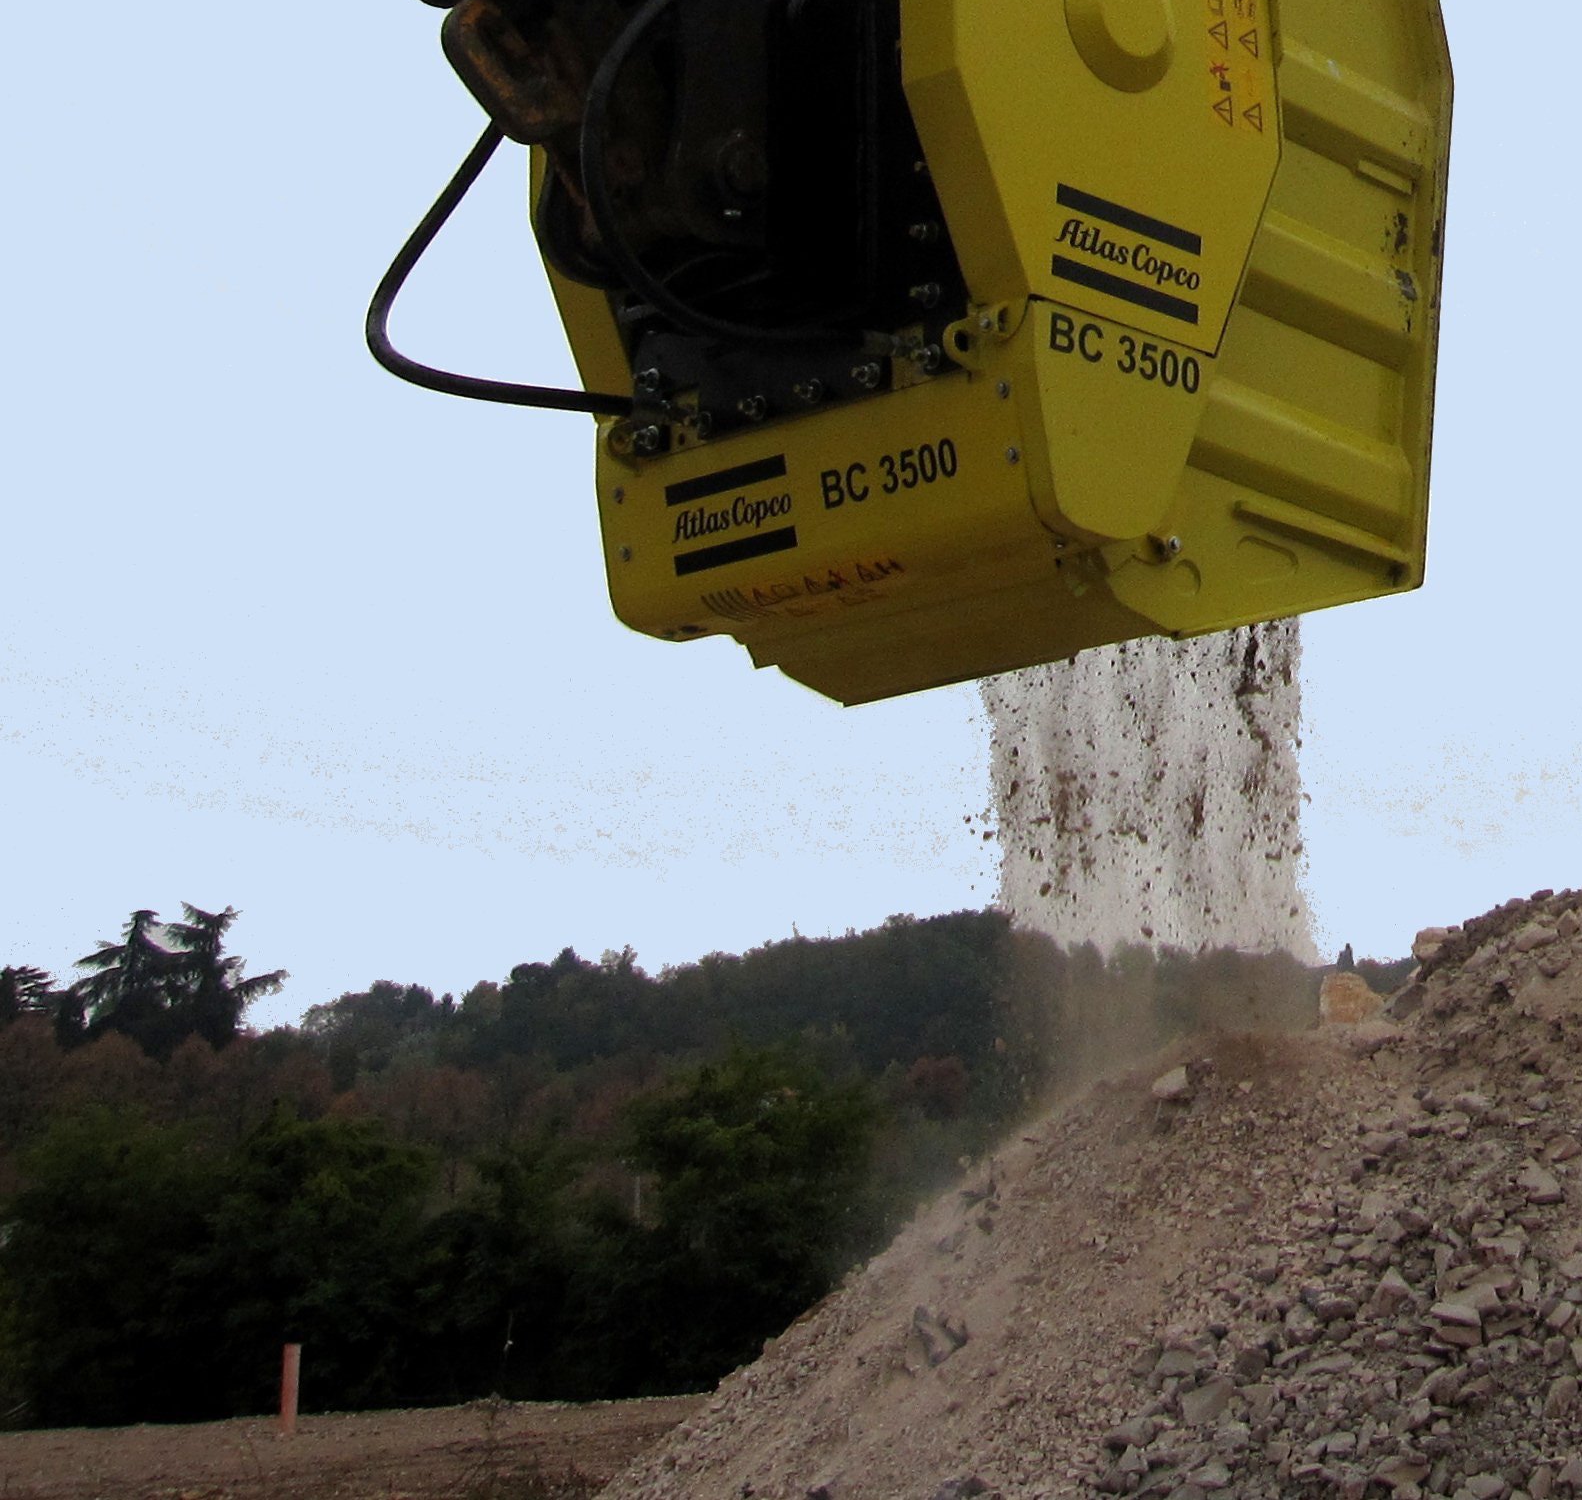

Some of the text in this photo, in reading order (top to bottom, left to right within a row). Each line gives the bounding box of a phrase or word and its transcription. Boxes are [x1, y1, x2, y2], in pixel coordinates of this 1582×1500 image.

[1055, 218, 1200, 290] Atlas Copco
[1050, 312, 1200, 394] BC 3500
[820, 438, 957, 510] BC 3500
[672, 493, 791, 543] Atlas Copco
